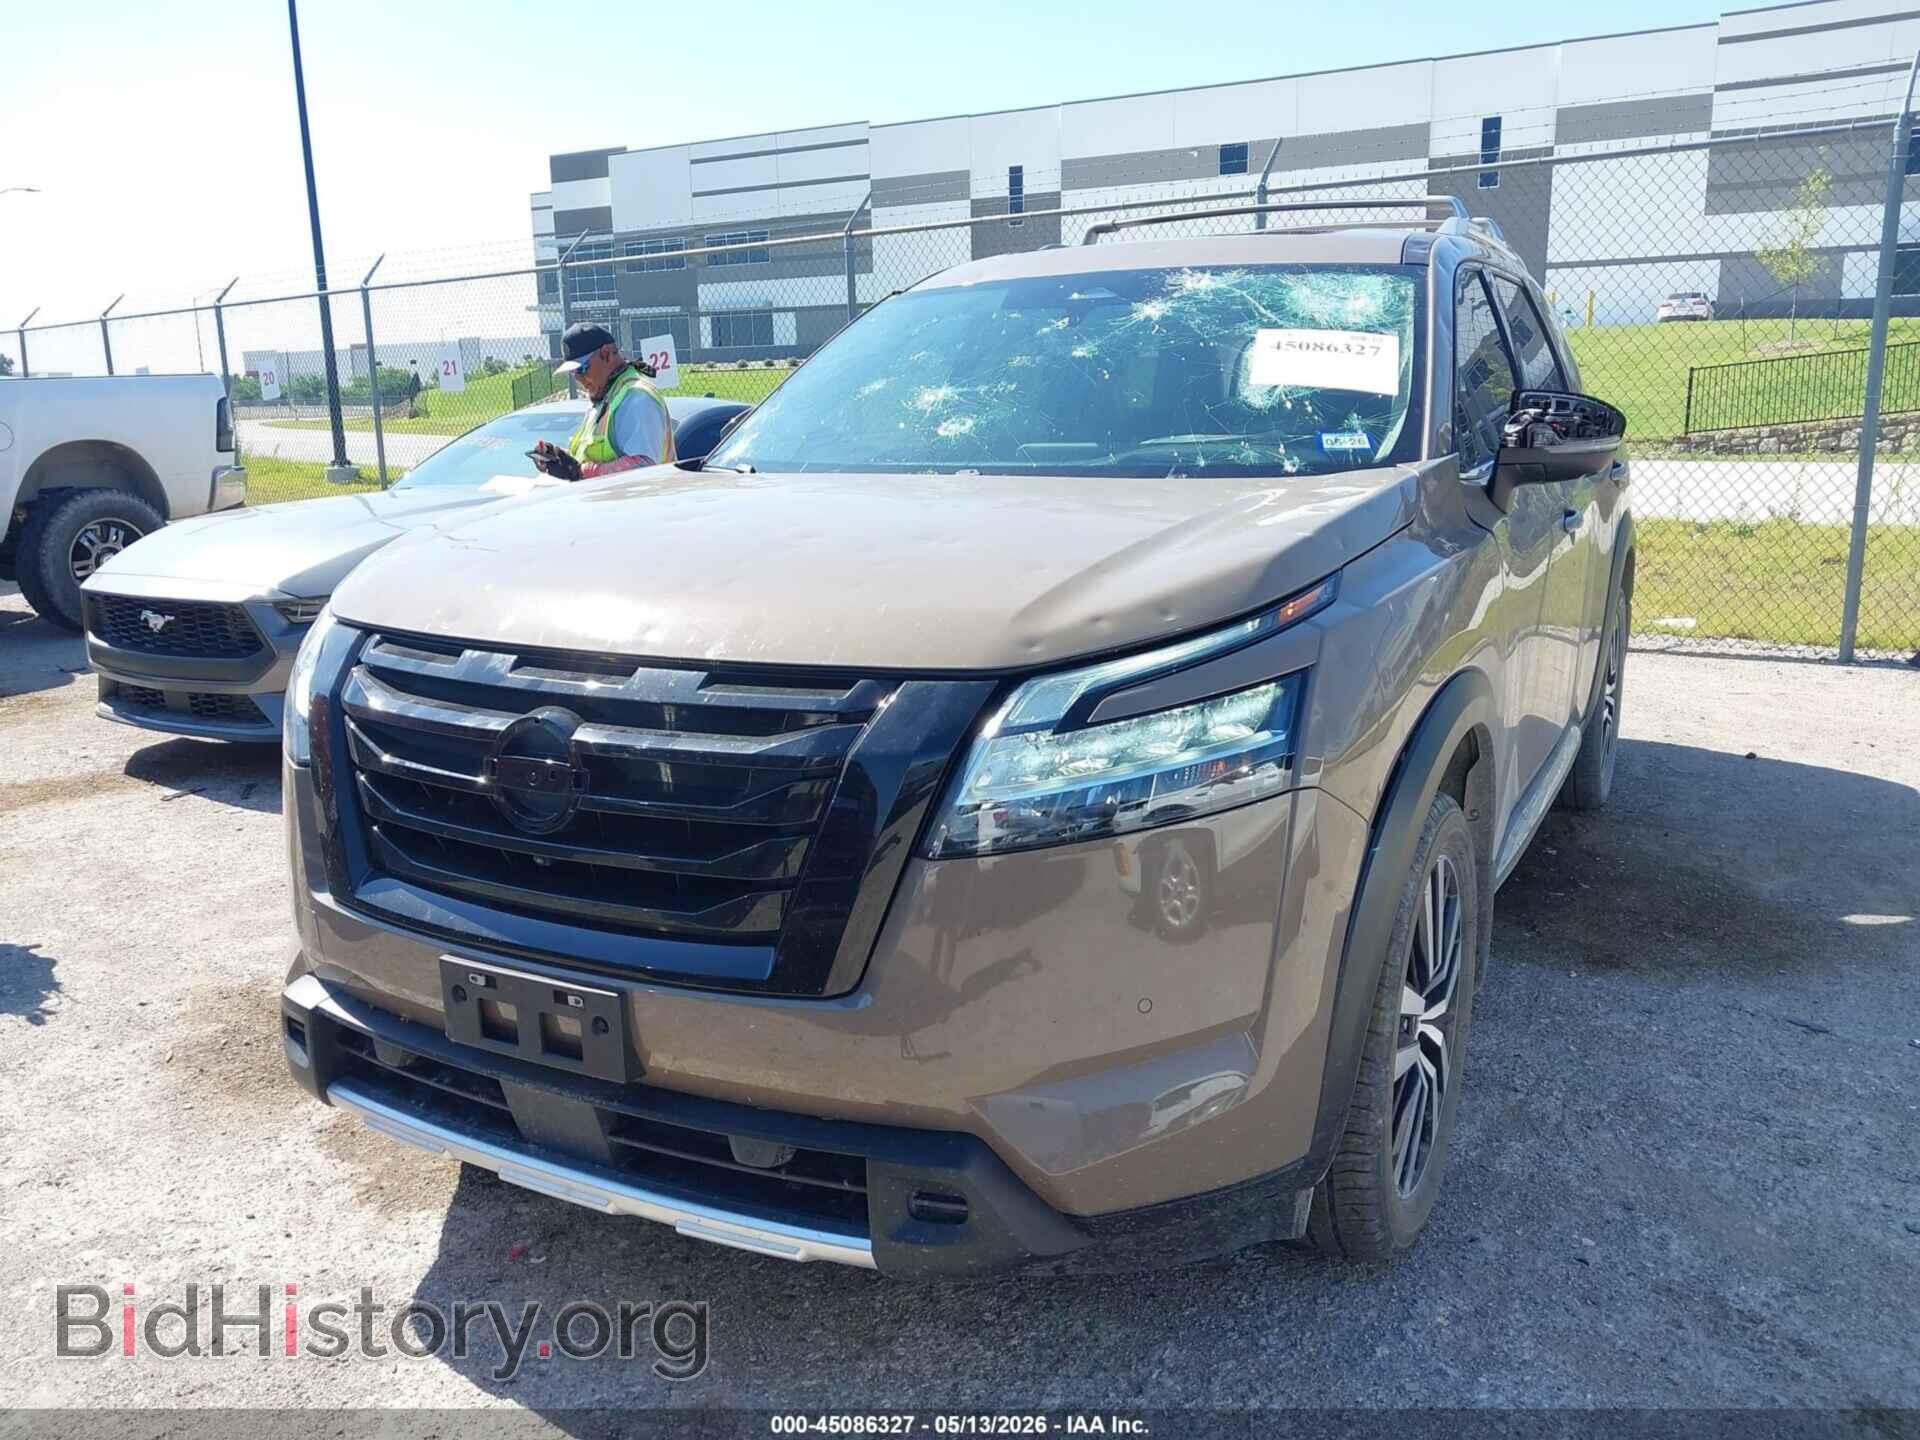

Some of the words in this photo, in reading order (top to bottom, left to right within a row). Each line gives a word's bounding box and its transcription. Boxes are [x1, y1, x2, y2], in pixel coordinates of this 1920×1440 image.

[1269, 340, 1382, 357] 45086327
[443, 360, 457, 376] 21
[650, 351, 671, 371] 22
[263, 371, 275, 386] 20
